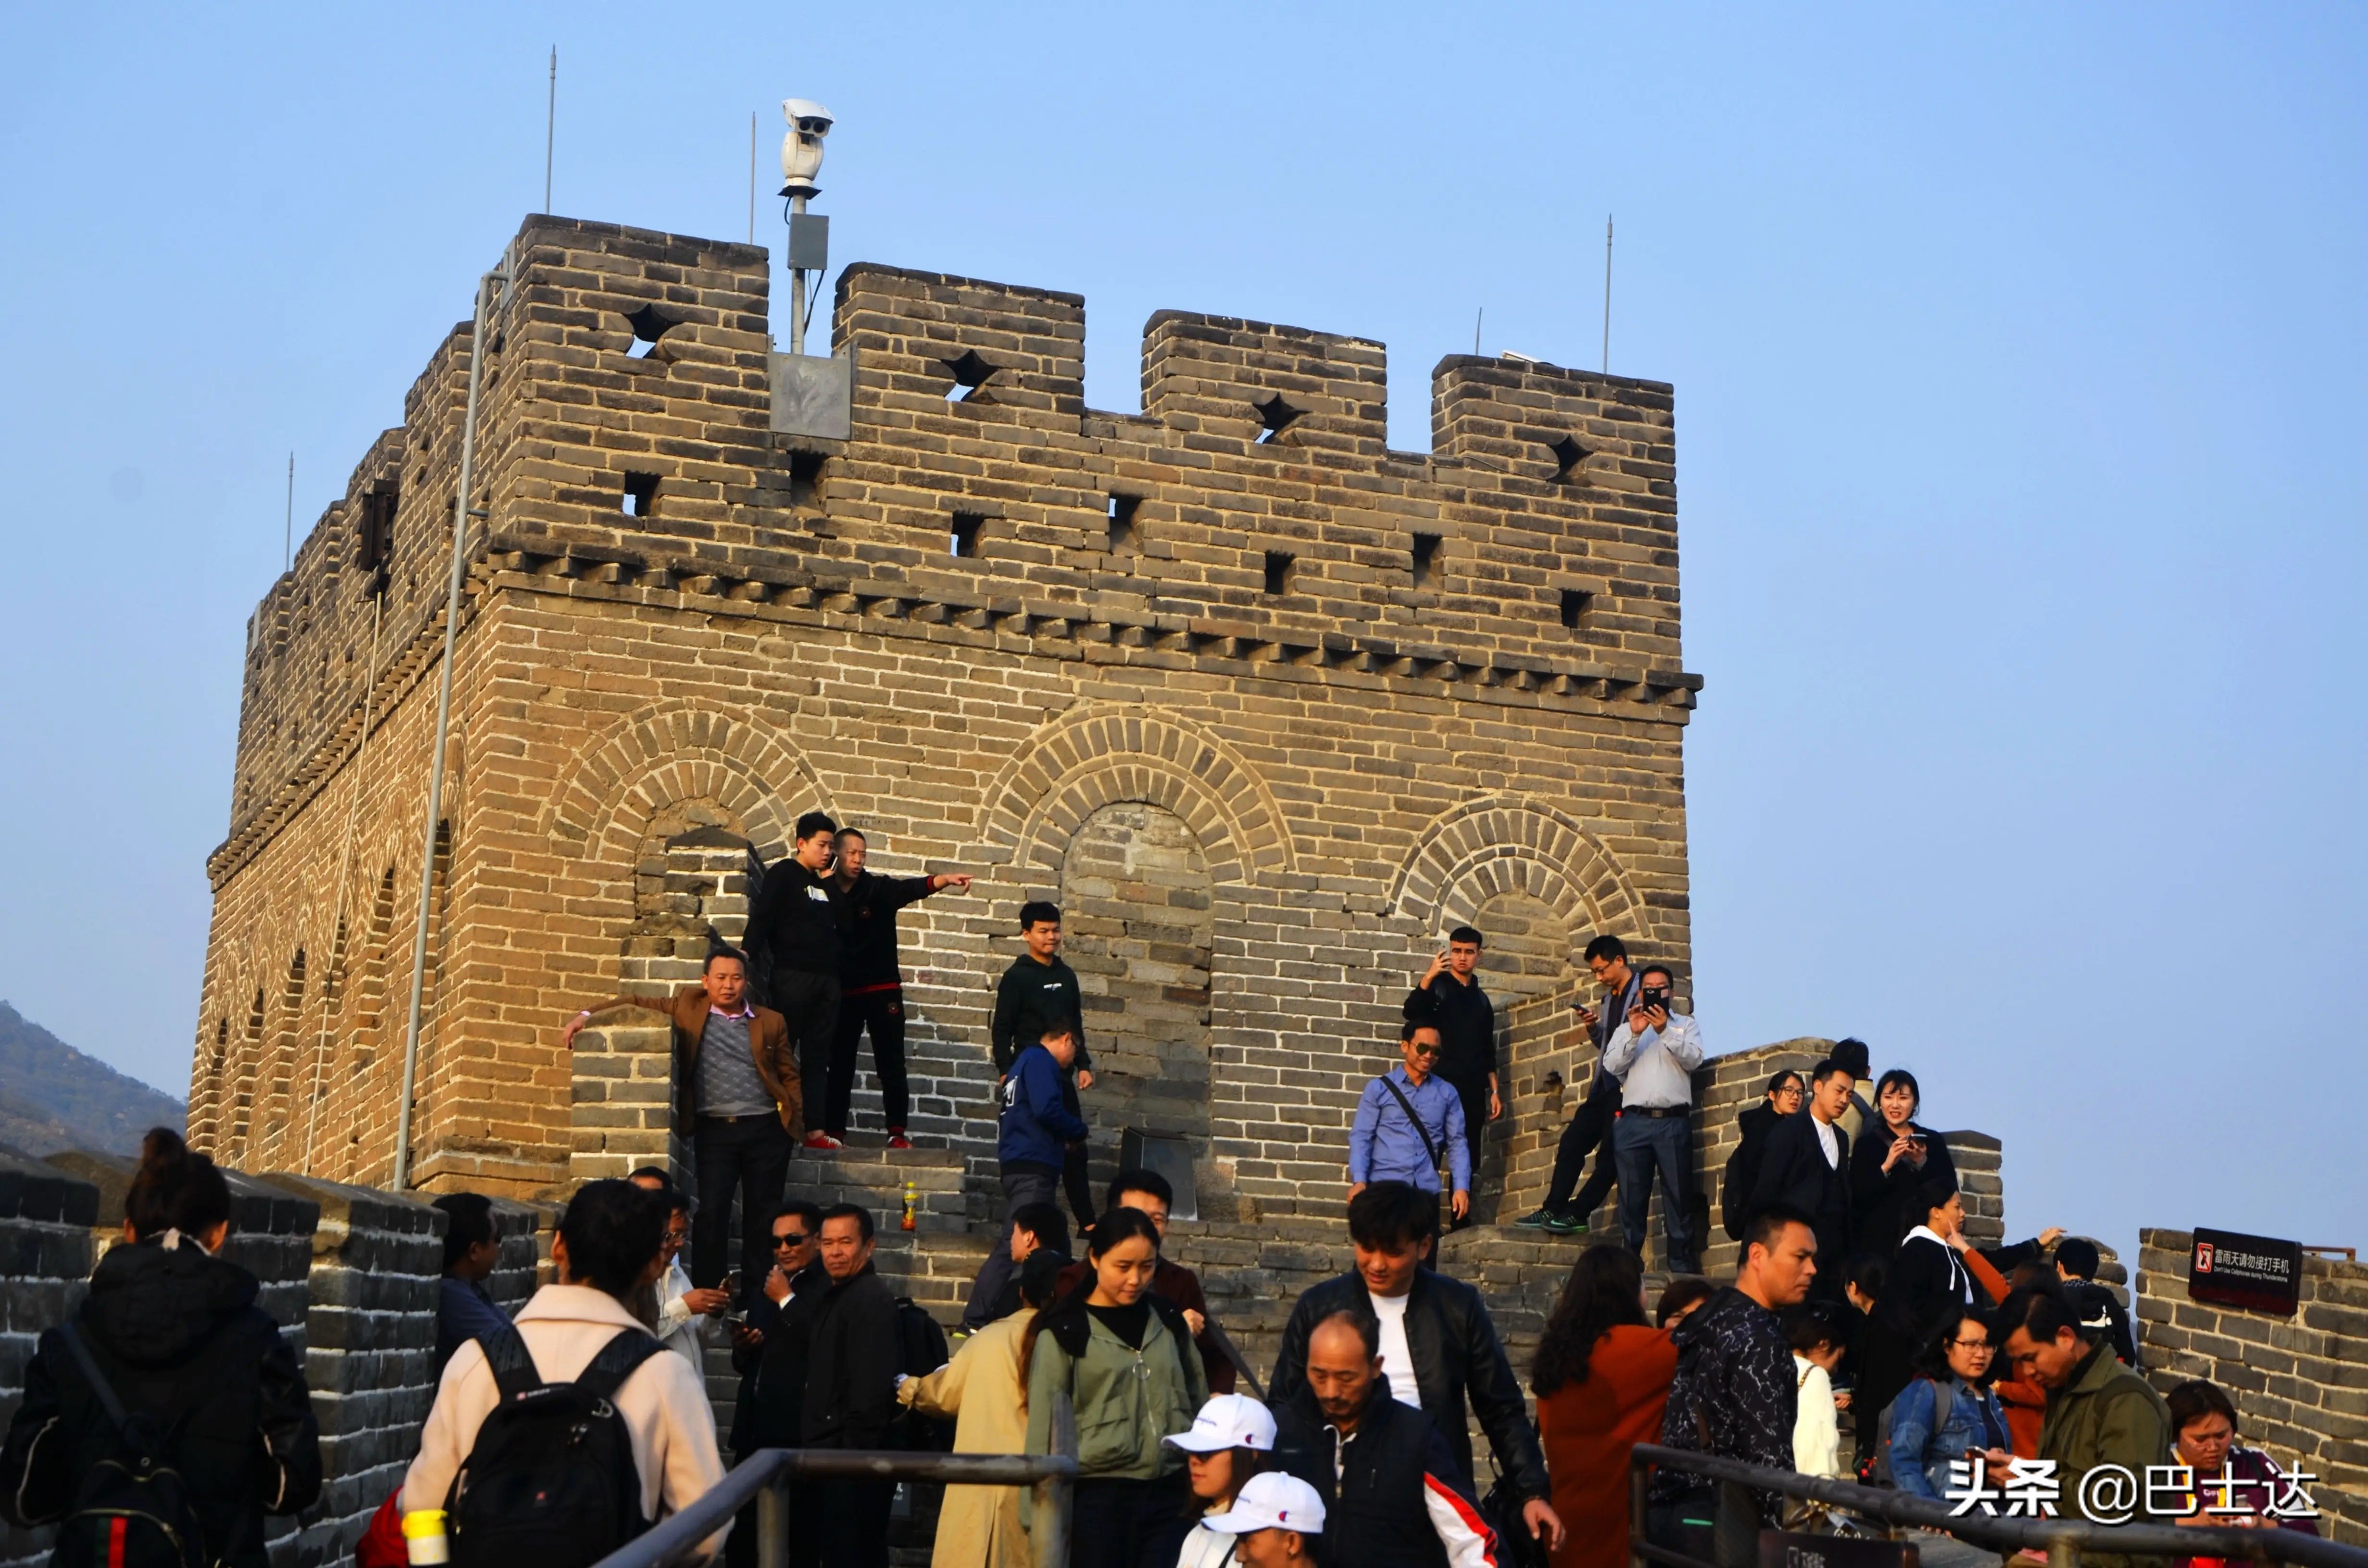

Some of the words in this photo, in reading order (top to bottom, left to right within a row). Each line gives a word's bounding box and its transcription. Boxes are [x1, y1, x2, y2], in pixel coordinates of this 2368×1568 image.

[2215, 1249, 2289, 1273] 雷雨天请勿接打手机
